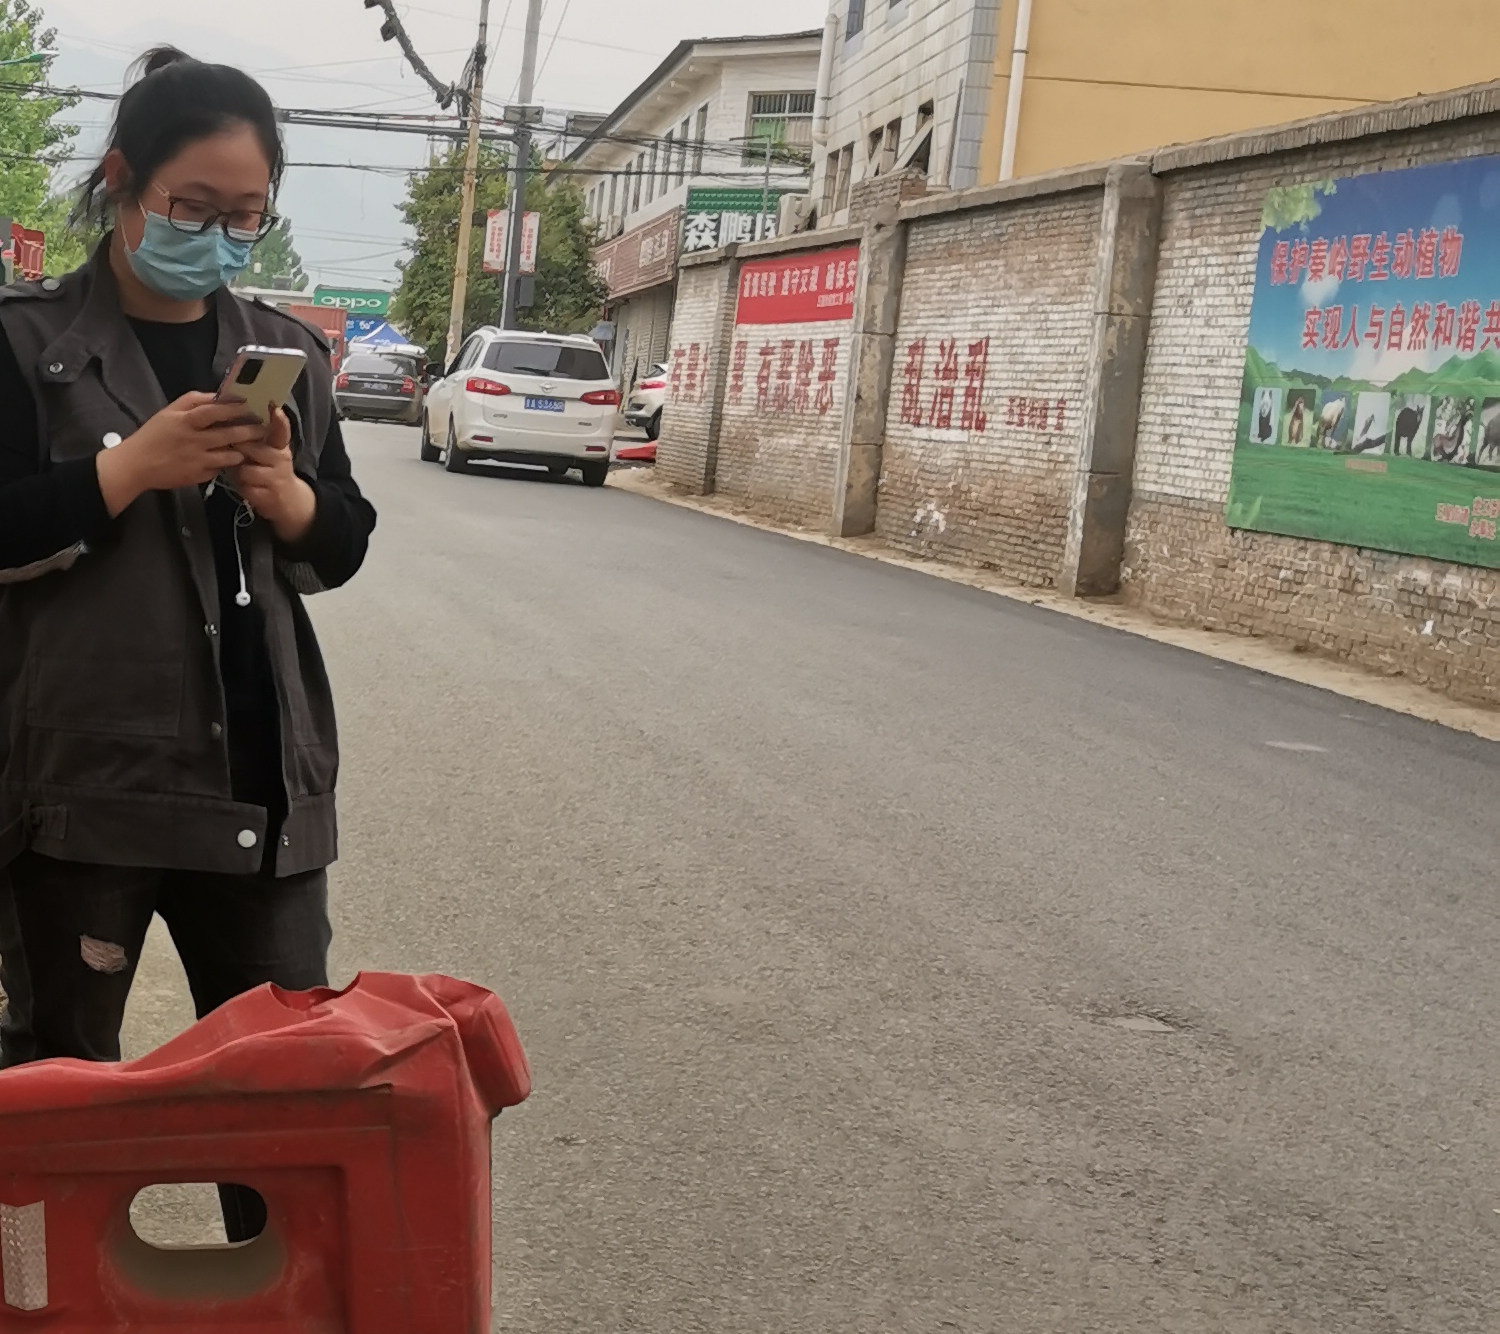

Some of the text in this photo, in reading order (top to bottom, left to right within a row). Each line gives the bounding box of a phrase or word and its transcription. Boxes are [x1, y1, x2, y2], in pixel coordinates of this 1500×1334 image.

[1271, 225, 1464, 285] 保护秦岭野生动植物
